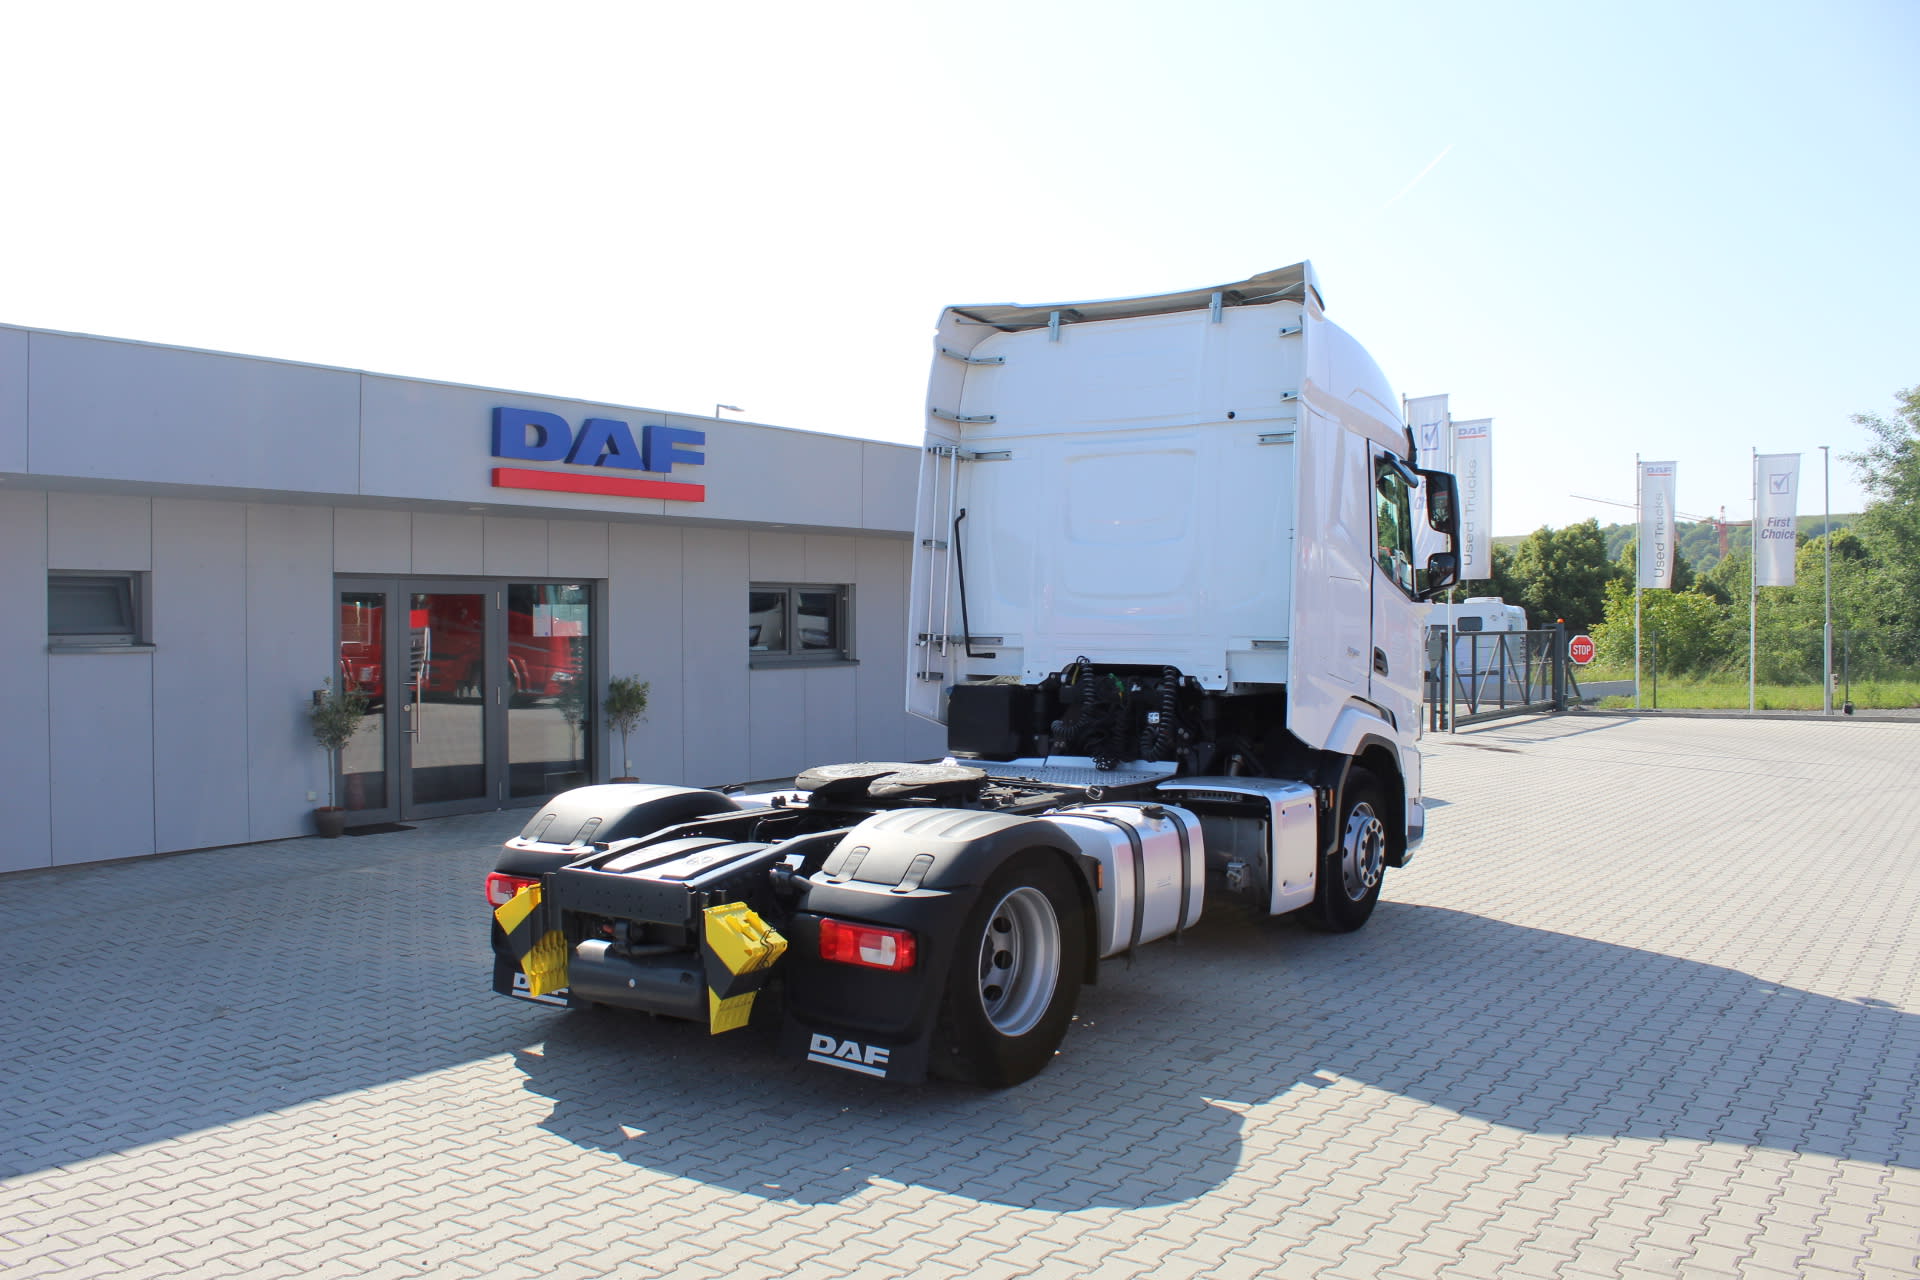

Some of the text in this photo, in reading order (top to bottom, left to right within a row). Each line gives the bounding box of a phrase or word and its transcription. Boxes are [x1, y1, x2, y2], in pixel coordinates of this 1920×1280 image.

[492, 407, 705, 473] DAF
[1458, 426, 1487, 435] DAF
[1463, 458, 1477, 566] Used Trucks
[1767, 516, 1791, 527] First
[1654, 492, 1664, 578] Used Trucks
[1761, 528, 1795, 539] Choice
[1572, 644, 1591, 655] STOP
[809, 1032, 890, 1064] DAF
